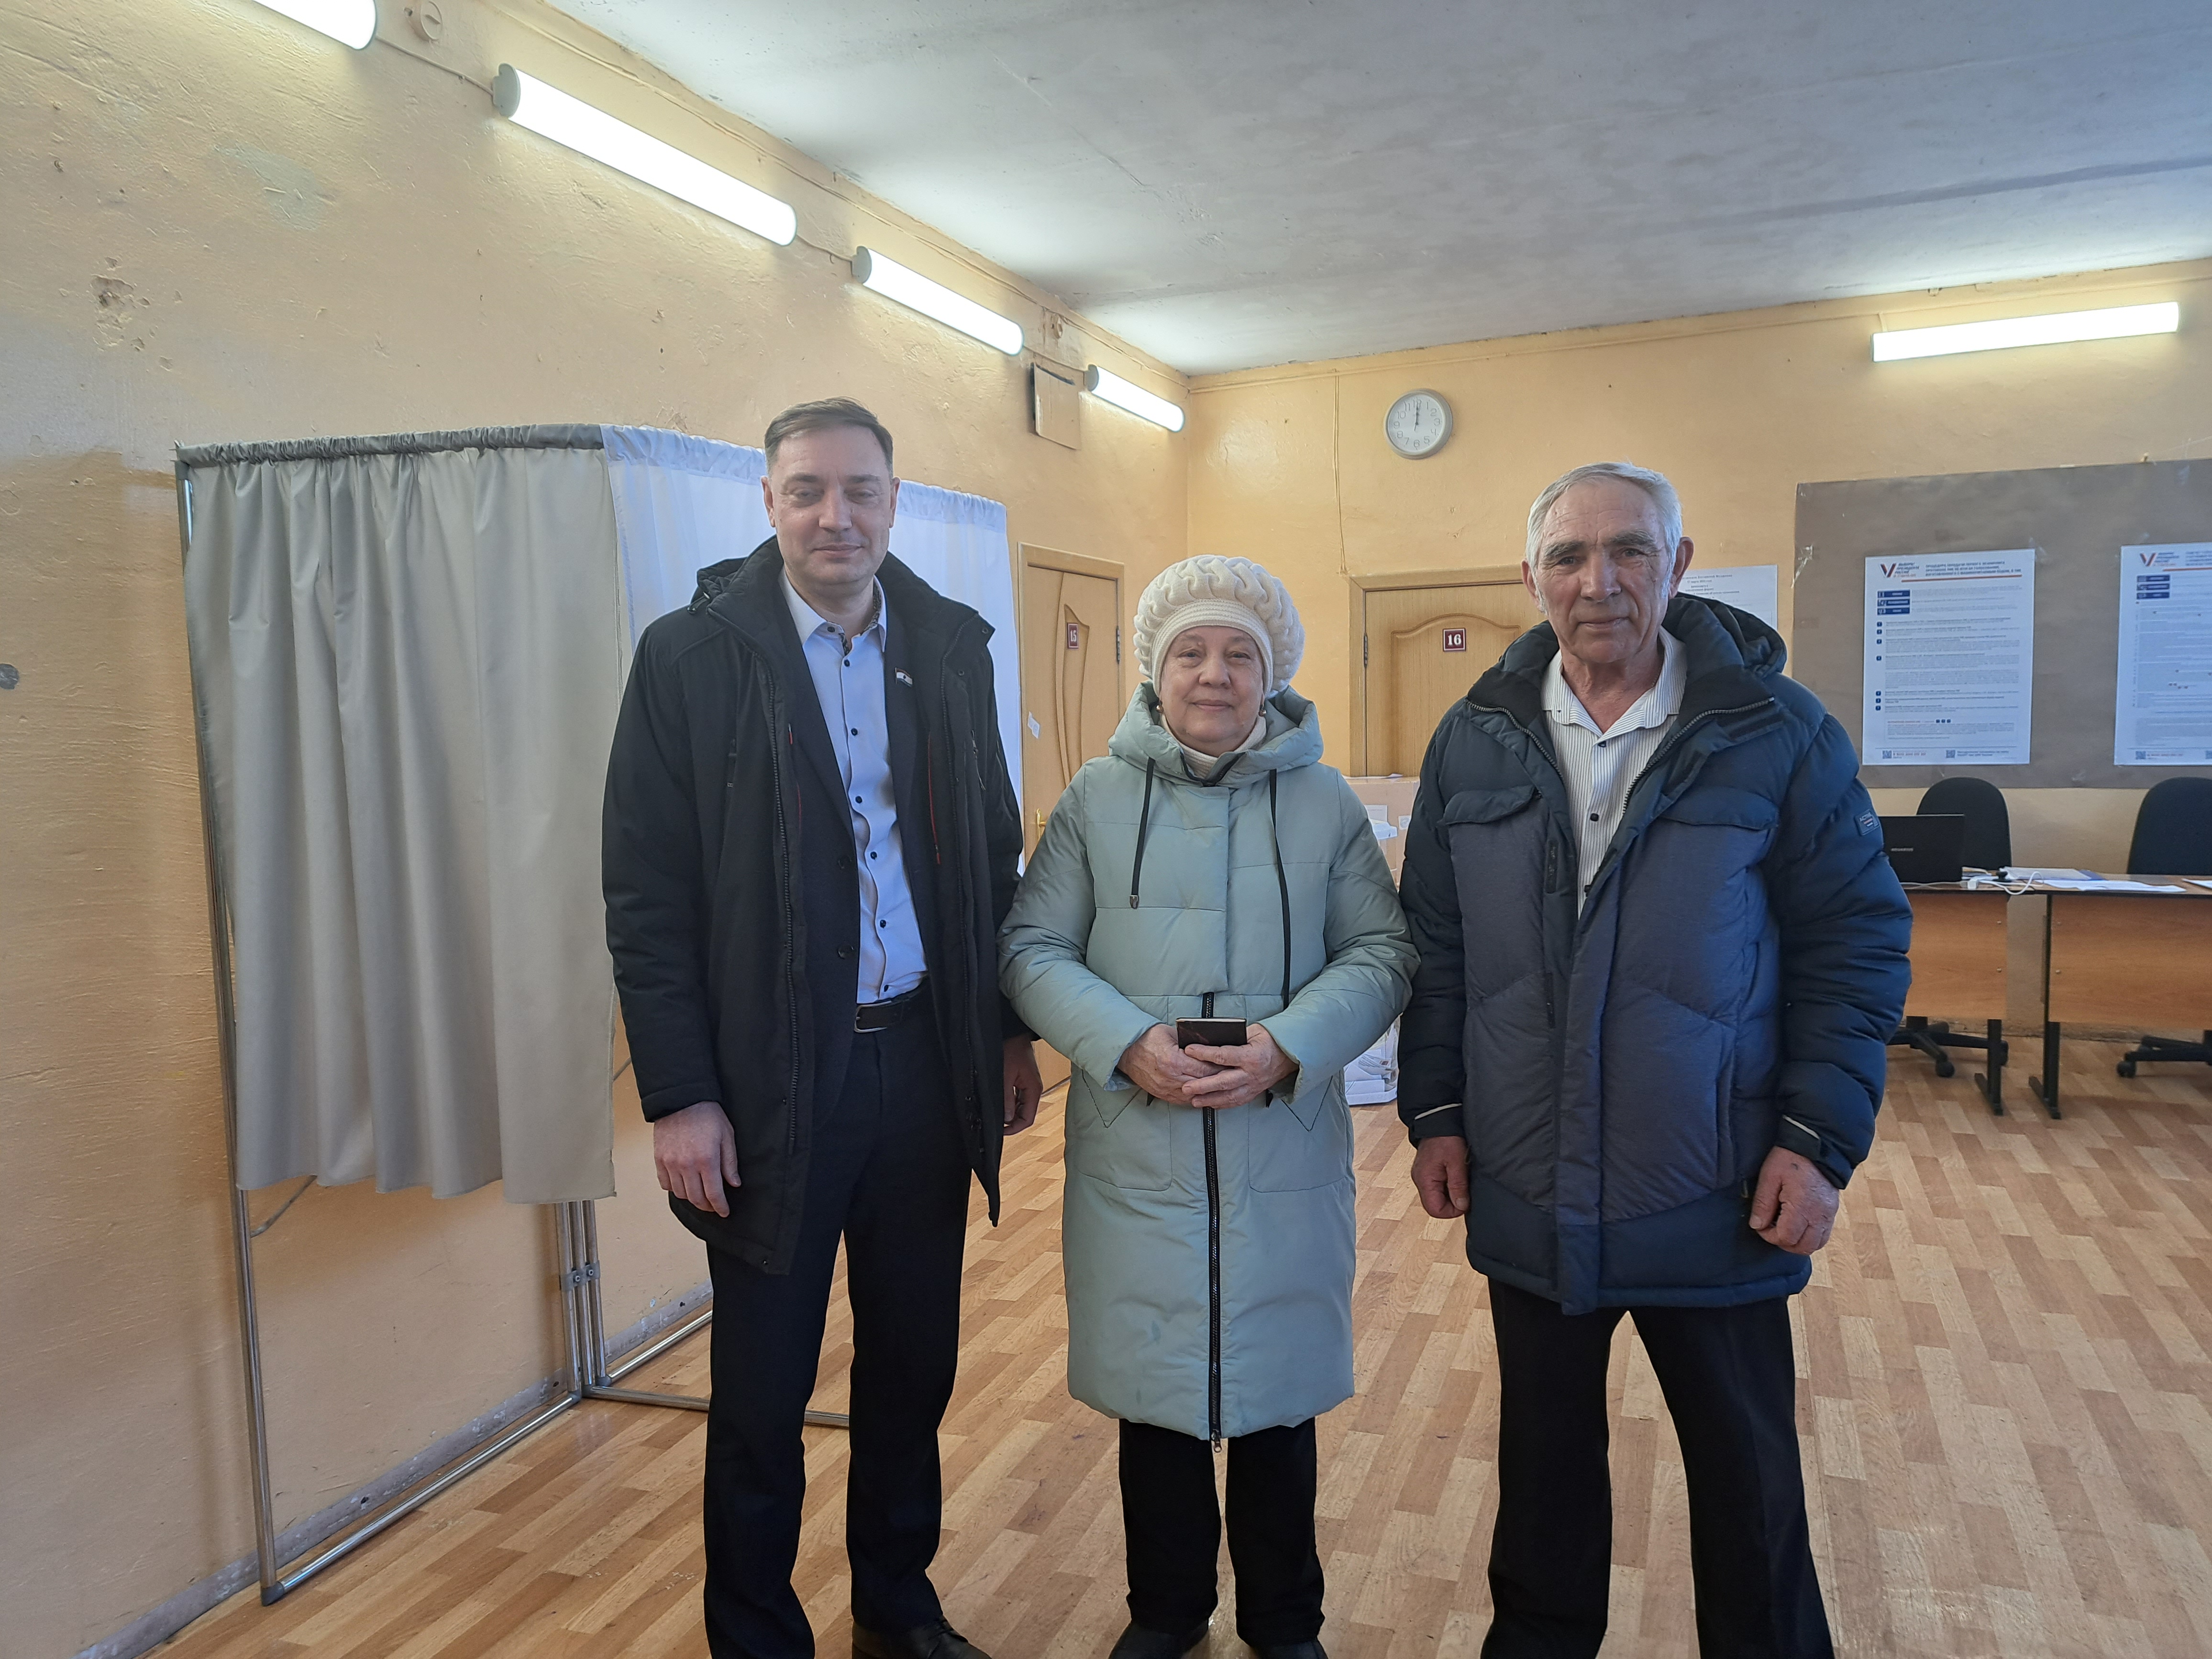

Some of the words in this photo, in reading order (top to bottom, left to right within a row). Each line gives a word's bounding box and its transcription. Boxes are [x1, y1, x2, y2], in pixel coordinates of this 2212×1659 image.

[1404, 401, 1410, 411] 11
[1430, 408, 1437, 417] 2
[1414, 440, 1420, 448] 6
[1424, 436, 1430, 444] 5
[1070, 630, 1077, 642] 15
[1448, 634, 1462, 646] 16
